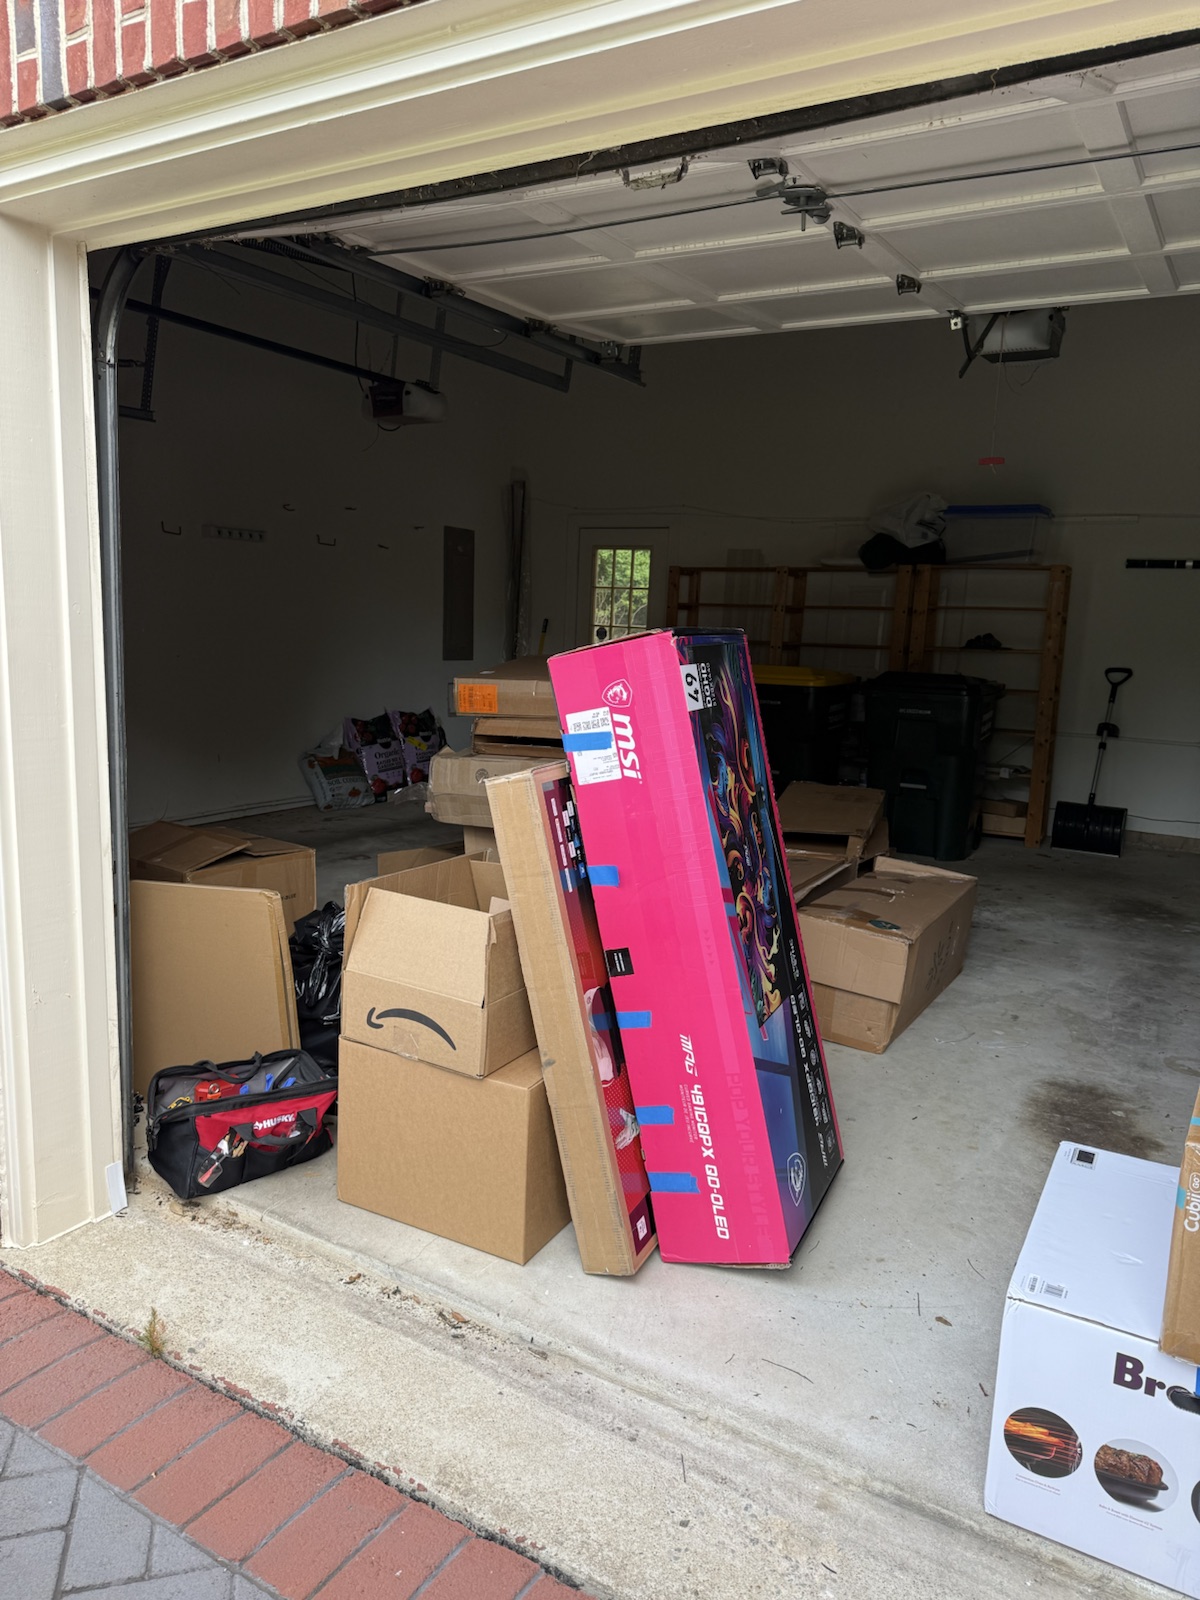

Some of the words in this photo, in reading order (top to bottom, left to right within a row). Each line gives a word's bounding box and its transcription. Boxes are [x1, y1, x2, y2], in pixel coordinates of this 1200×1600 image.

[685, 672, 700, 703] 49
[612, 713, 640, 780] msi
[263, 1113, 294, 1129] HUSKY
[679, 1033, 698, 1077] MPG
[690, 1084, 715, 1160] 491CQPX
[704, 1163, 730, 1240] QD-OLED
[1184, 1193, 1200, 1232] Cubii
